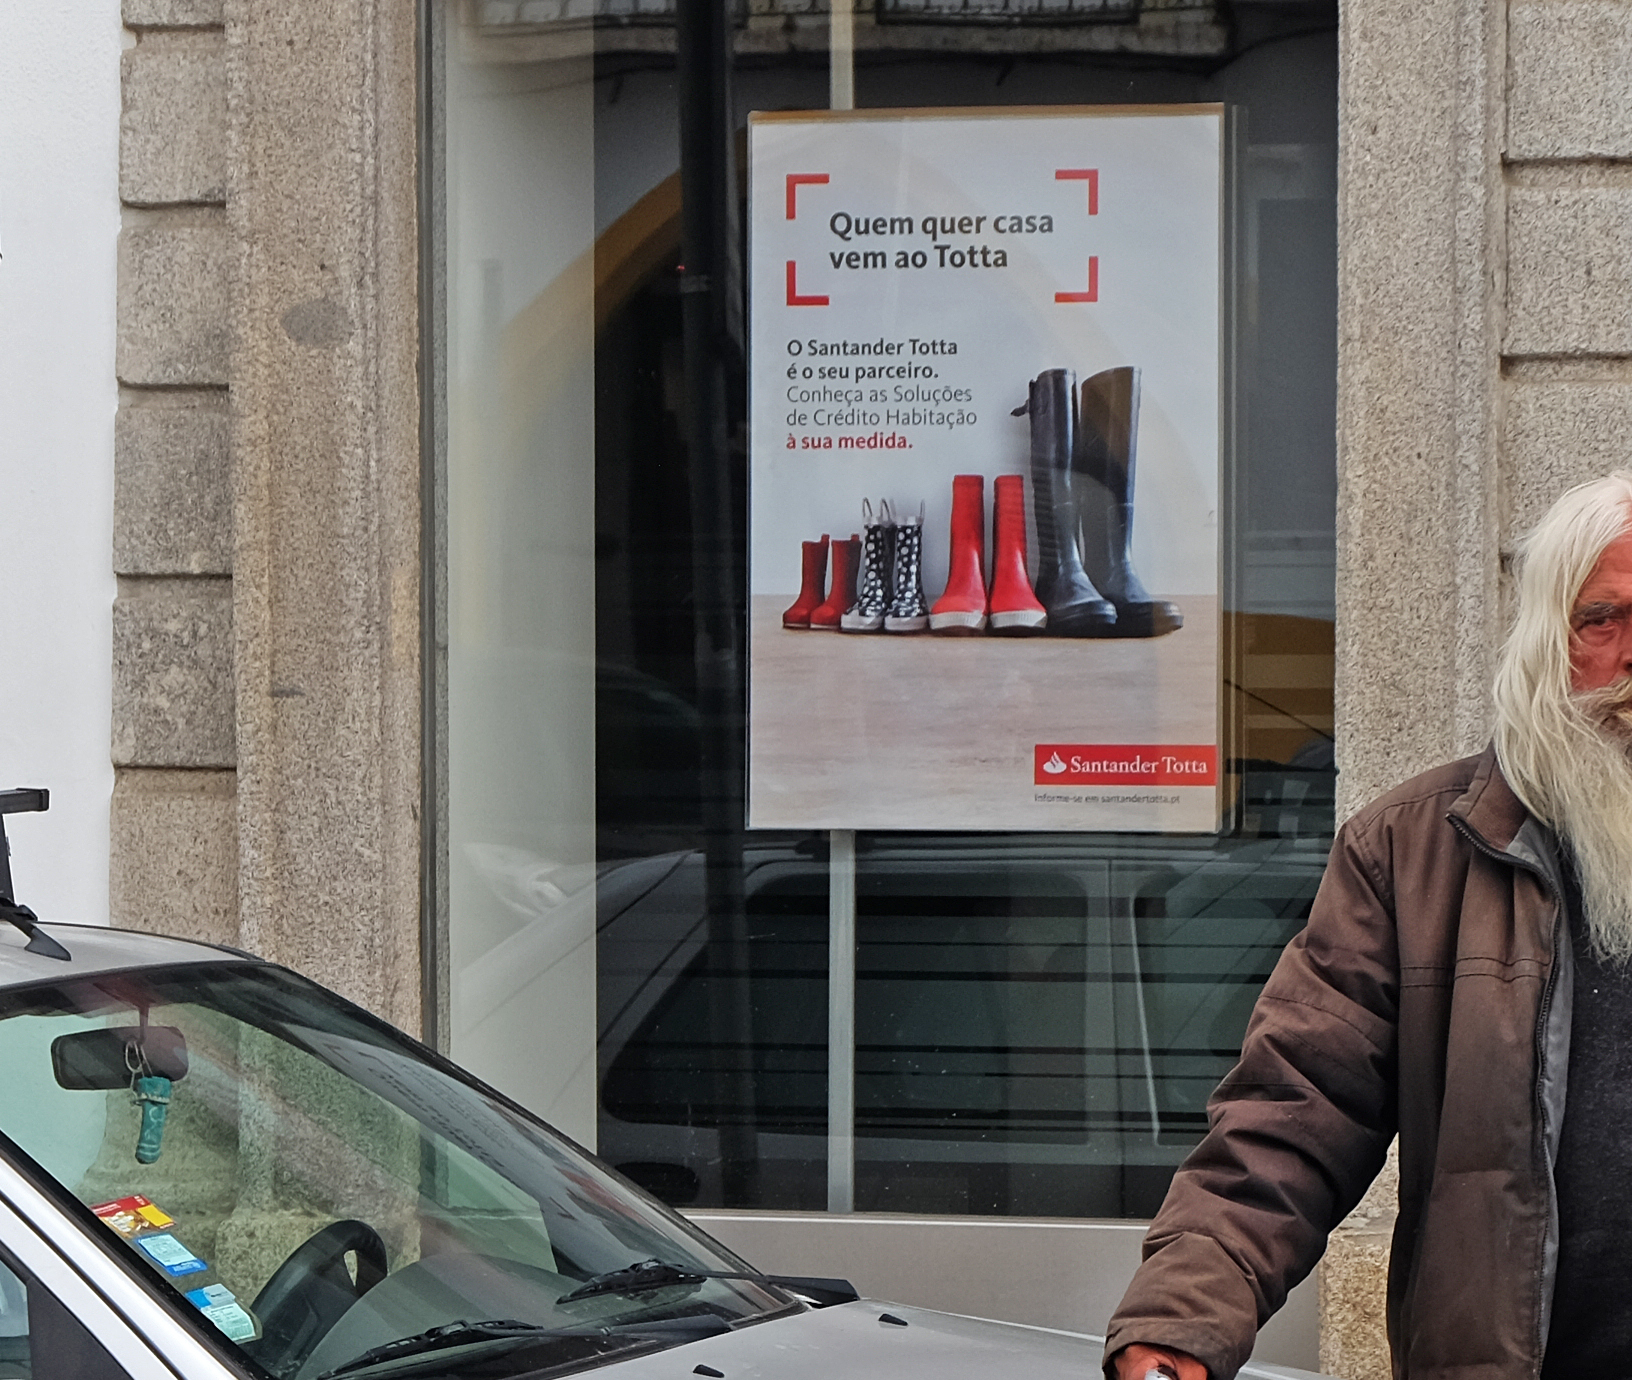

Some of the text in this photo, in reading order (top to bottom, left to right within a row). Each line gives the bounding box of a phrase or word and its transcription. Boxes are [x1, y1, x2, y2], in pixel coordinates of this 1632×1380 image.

[829, 212, 1054, 241] Quem quer casa
[829, 244, 1009, 270] vem ao Totta
[786, 338, 959, 357] O Santander Totta
[786, 361, 940, 384] é o seu parceiro.
[786, 384, 973, 407] Conheça as Soluções
[786, 407, 978, 430] de Crédito Habitação
[786, 430, 914, 450] à sua medida.
[1070, 754, 1209, 774] Santander Totta
[1034, 793, 1083, 803] Informe-se
[1100, 794, 1180, 805] santandertotta.pt
